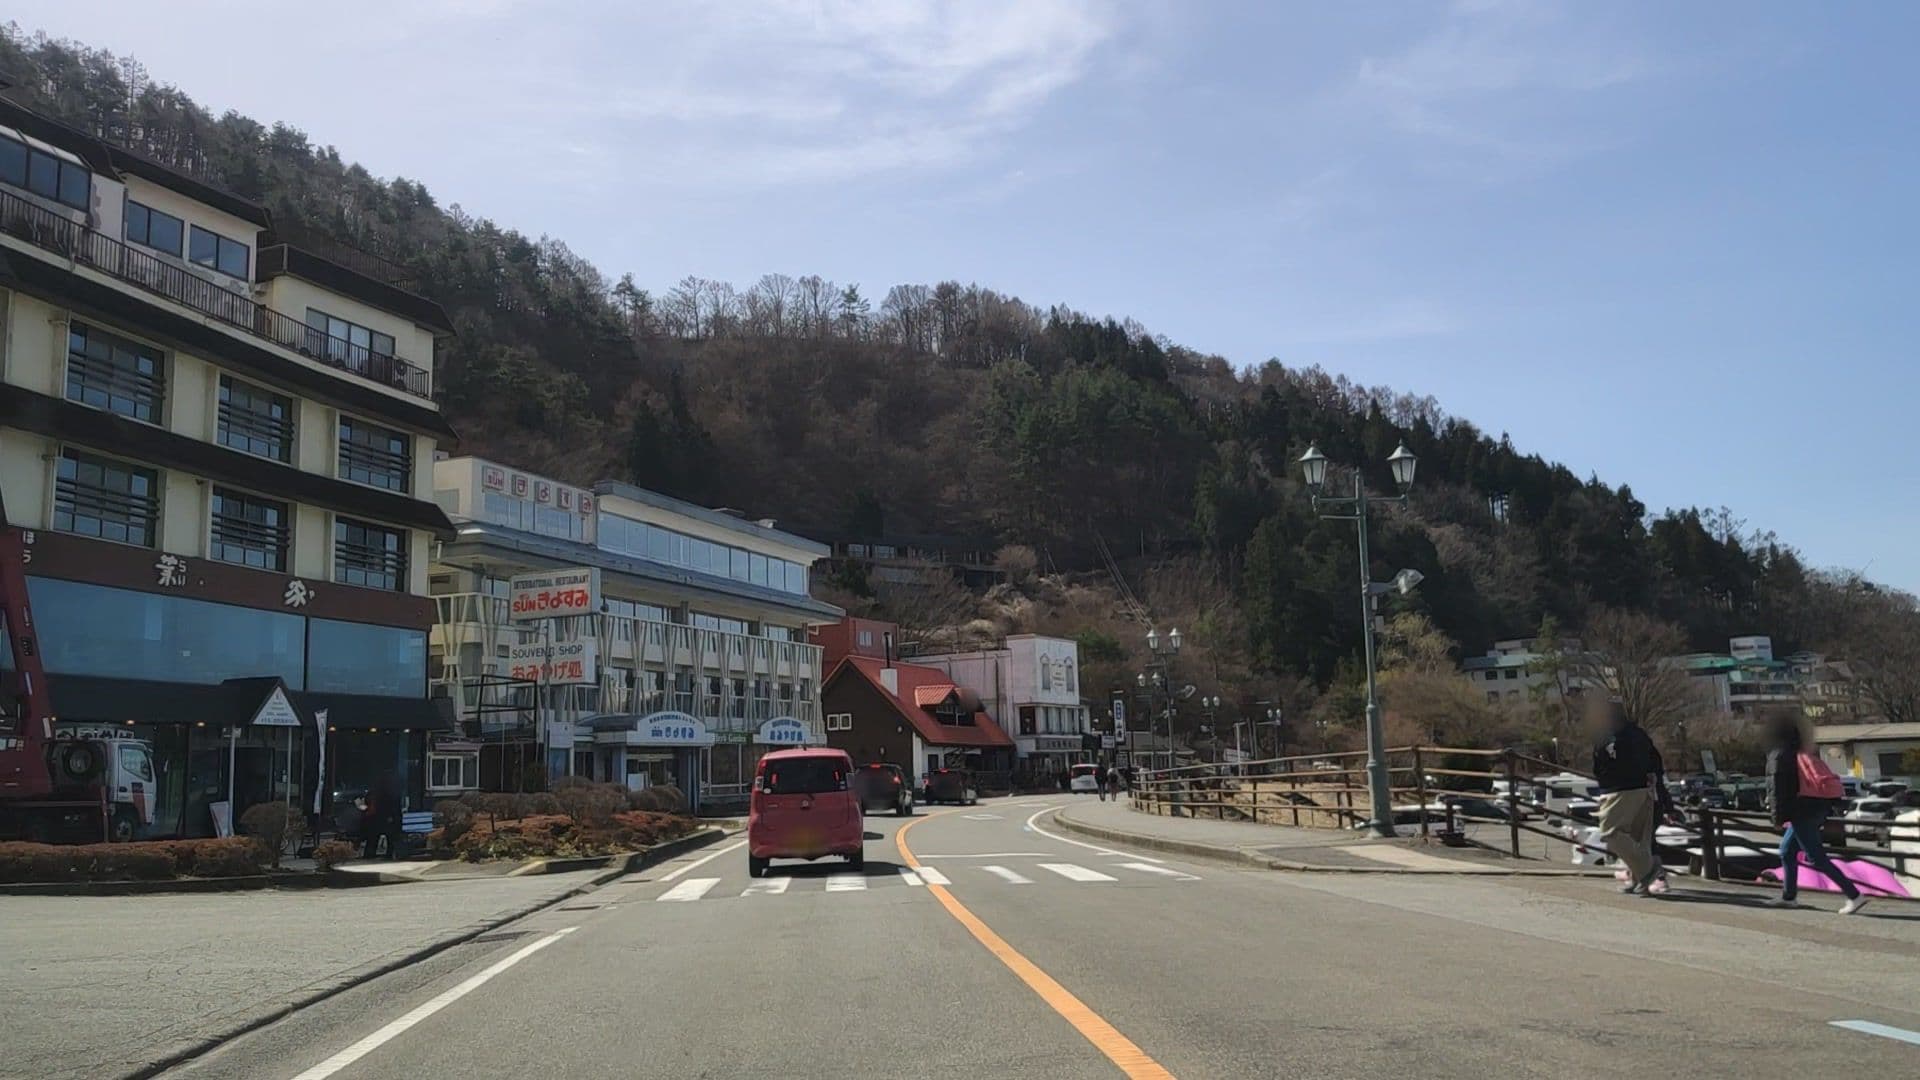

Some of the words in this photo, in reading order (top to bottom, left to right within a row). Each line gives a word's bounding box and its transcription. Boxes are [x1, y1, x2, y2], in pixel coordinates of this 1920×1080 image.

[514, 578, 553, 590] INTERNATIONAL
[555, 574, 589, 587] RESTAURANT
[512, 646, 555, 659] SOUVENR
[558, 644, 583, 656] SHOP
